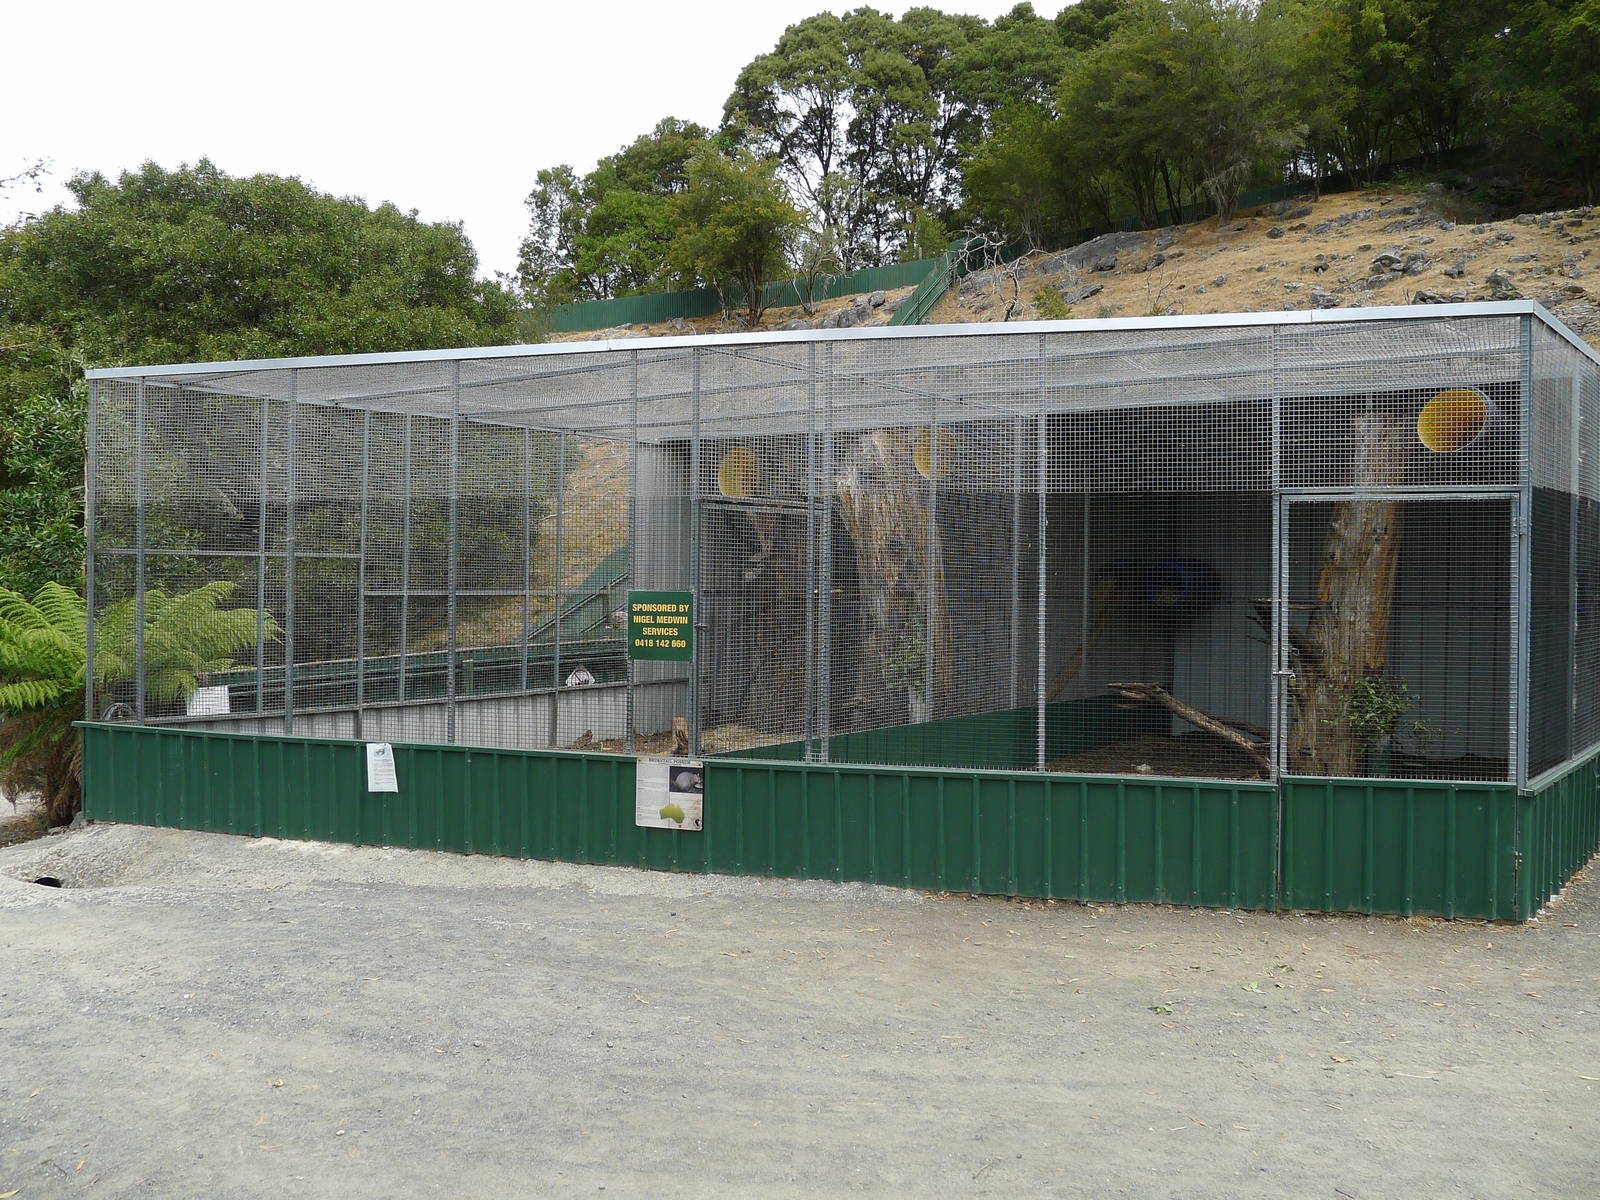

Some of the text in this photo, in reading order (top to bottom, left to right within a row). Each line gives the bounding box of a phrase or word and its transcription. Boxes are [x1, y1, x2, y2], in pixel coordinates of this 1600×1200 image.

[632, 603, 689, 613] SPONSORED BY
[633, 615, 688, 625] NIGEL MEDWIN
[642, 627, 678, 636] SERVICES
[635, 638, 653, 647] 0418
[656, 639, 669, 648] 142
